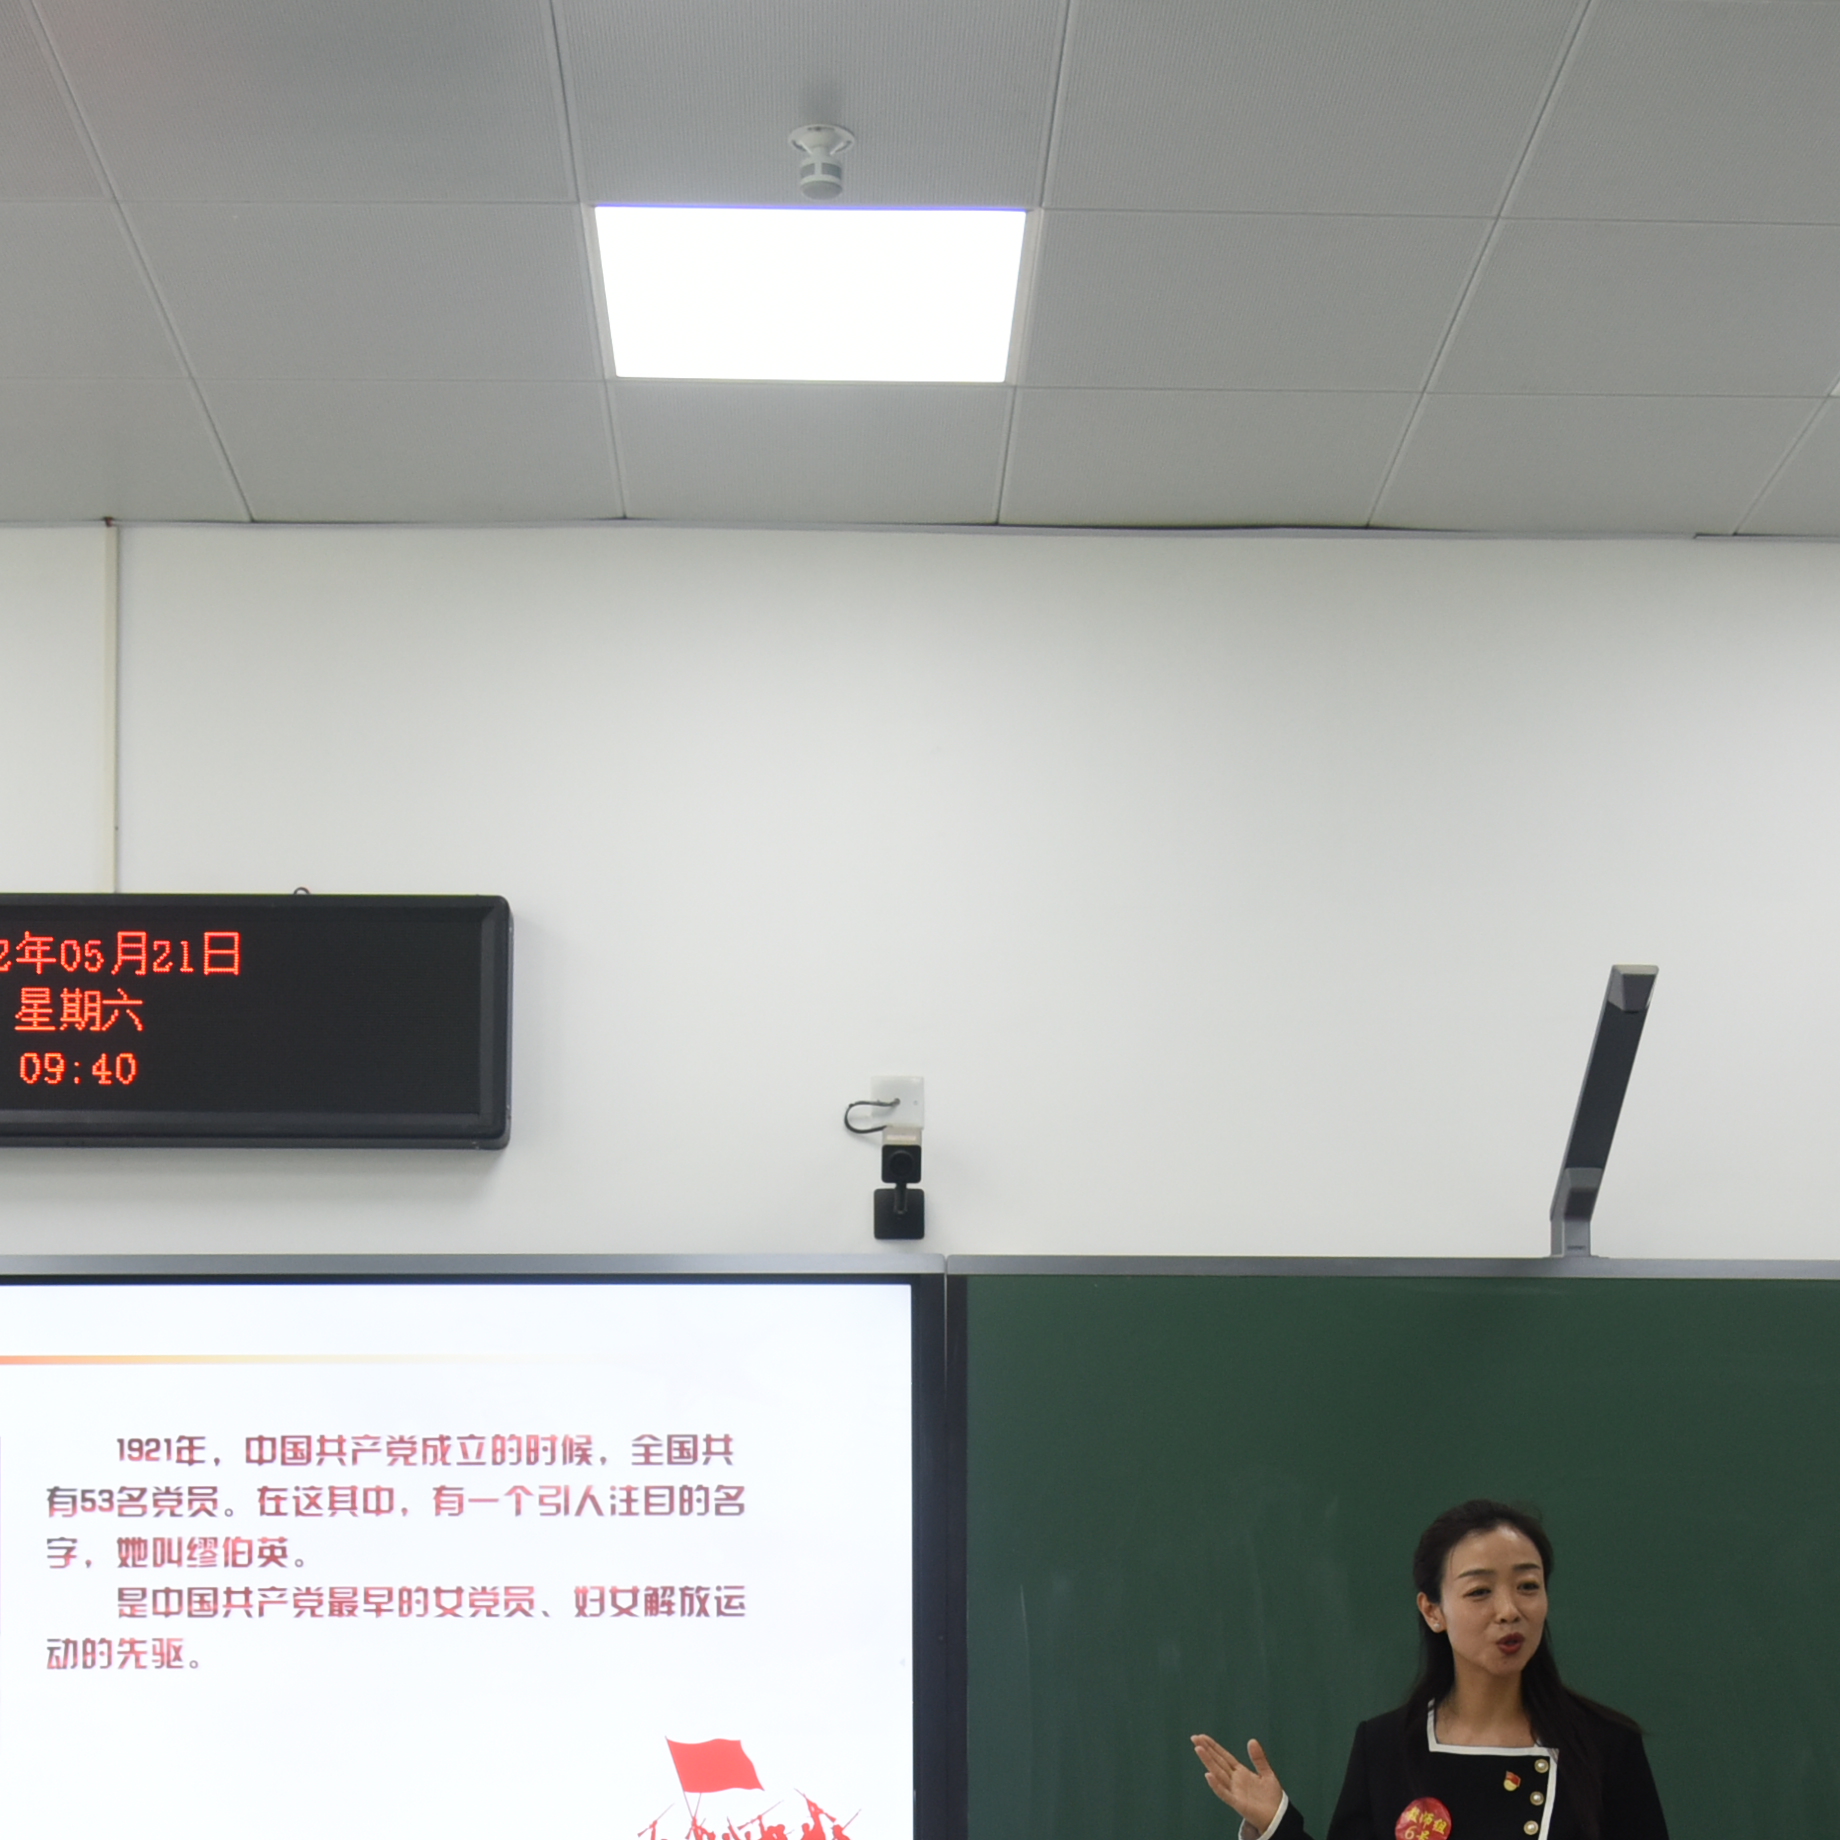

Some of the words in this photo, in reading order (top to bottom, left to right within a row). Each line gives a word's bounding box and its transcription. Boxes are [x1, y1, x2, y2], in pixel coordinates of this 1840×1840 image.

[14, 987, 143, 1031] 星期六
[19, 1051, 137, 1085] 09:40
[116, 1433, 733, 1467] 1921年，中国共产党成立的时候，全国共
[46, 1484, 745, 1518] 有53名党员。在这其中，有一个引人注目的名
[46, 1536, 306, 1569] 字，她叫缪伯英。
[117, 1585, 746, 1619] 是中国共产党最早的女党员、妇女解放运
[46, 1637, 201, 1670] 动的先驱。
